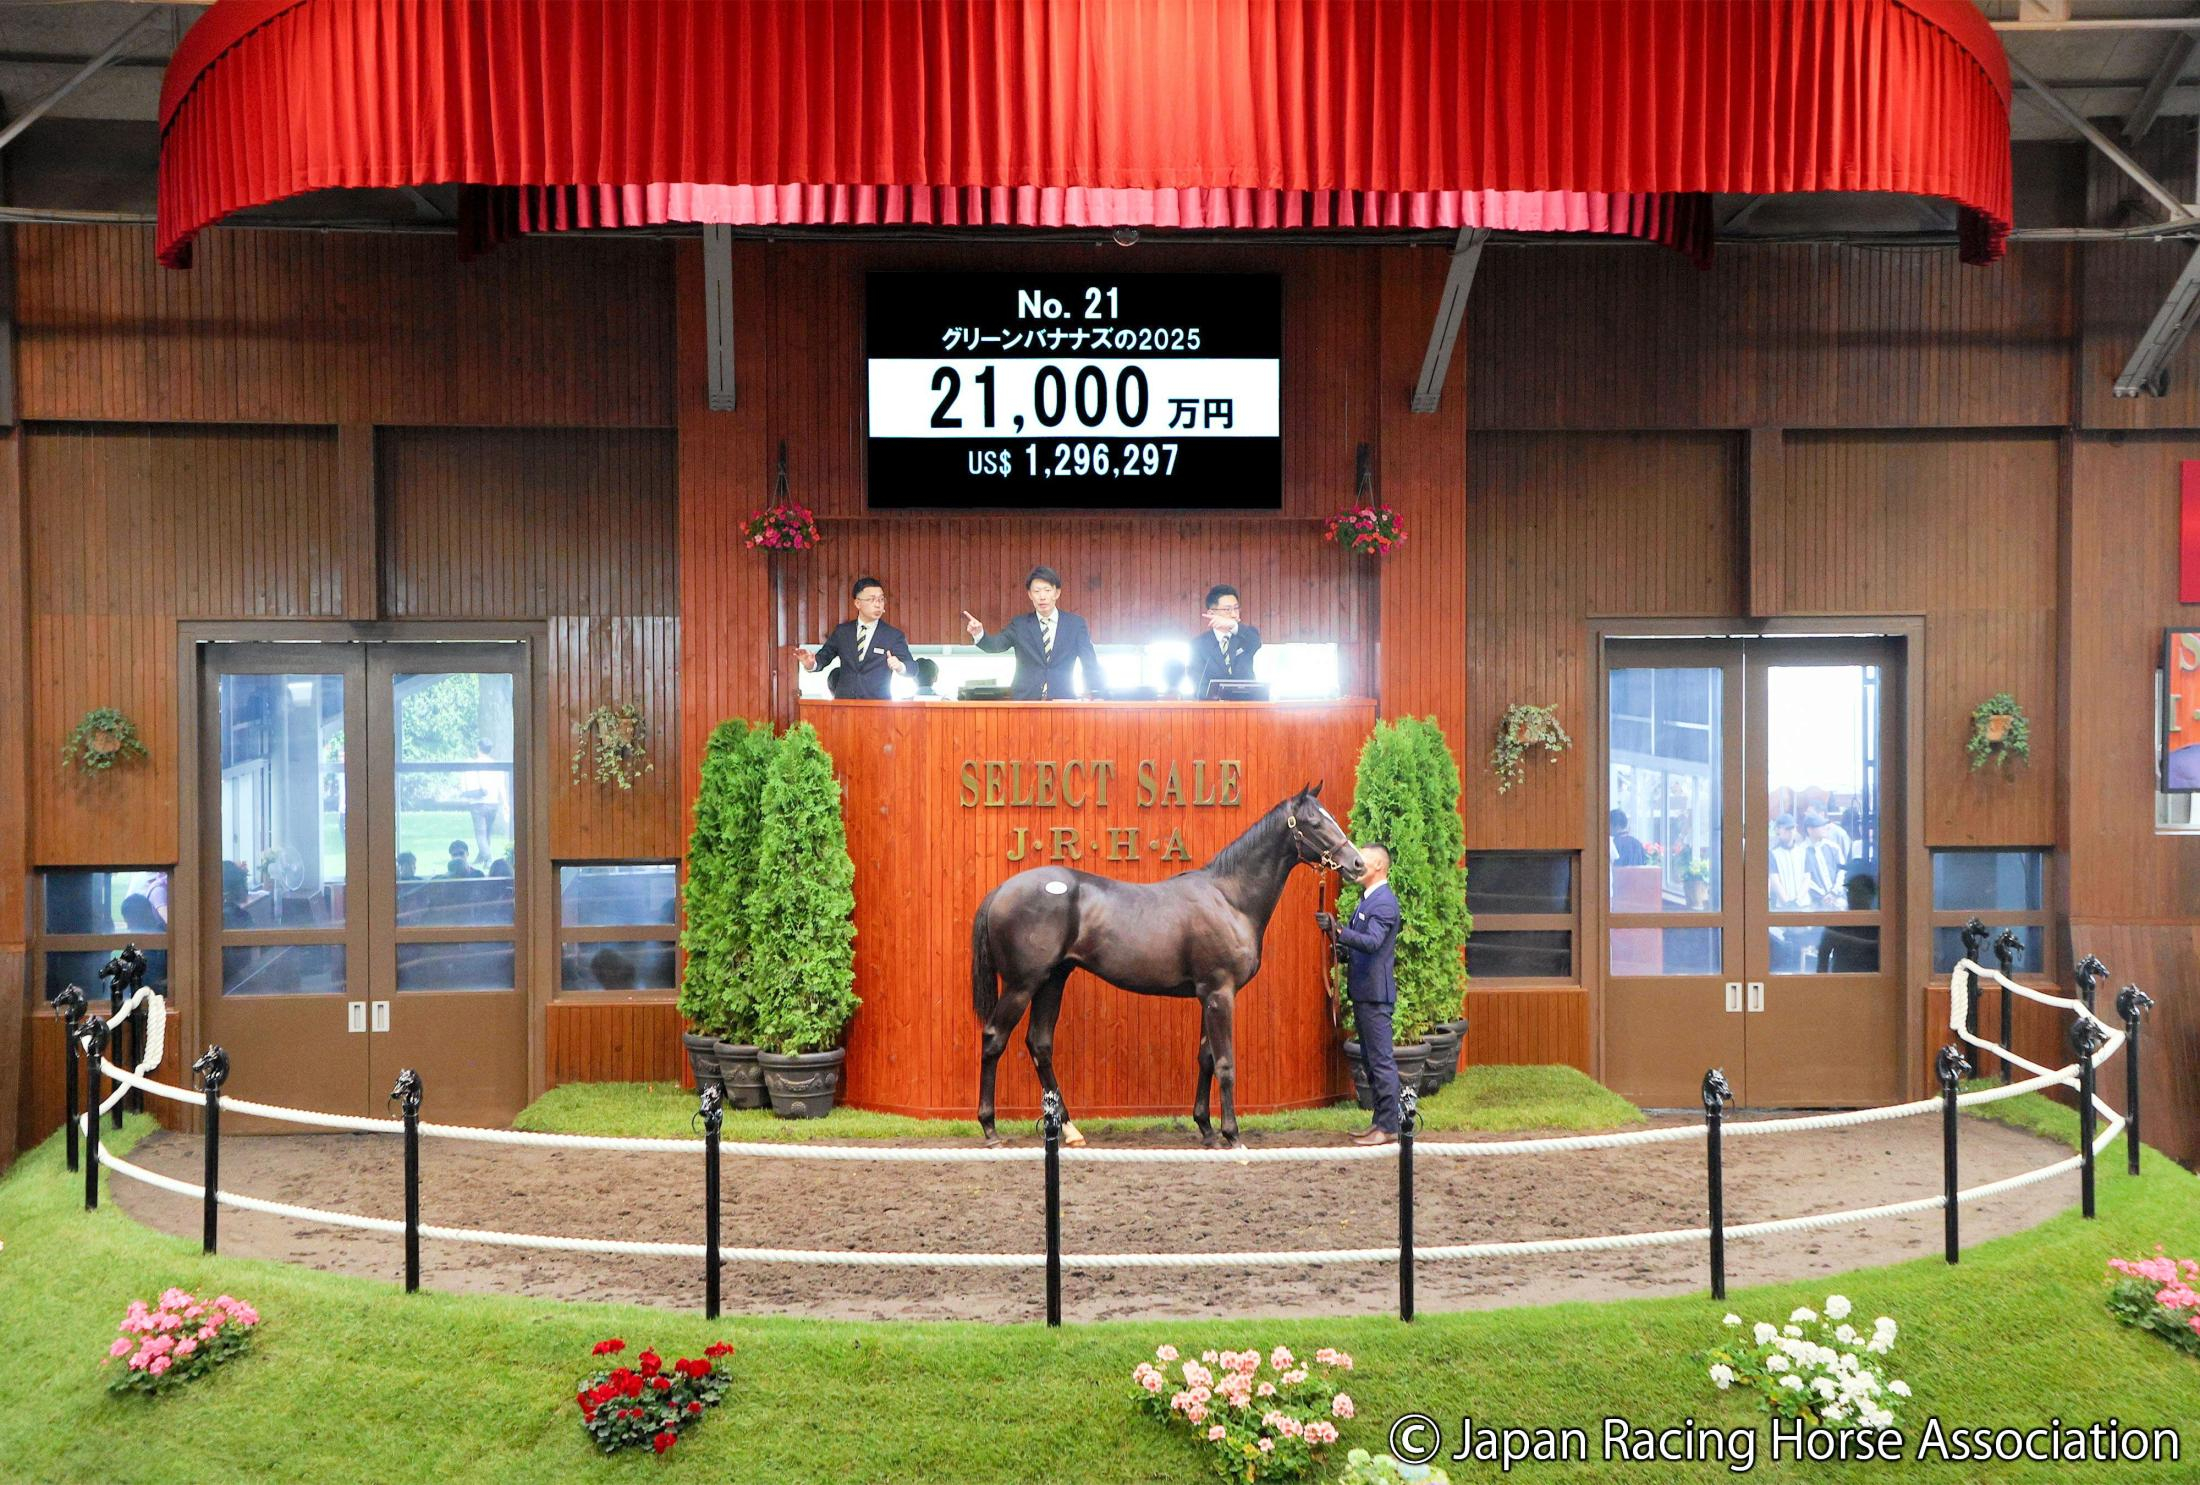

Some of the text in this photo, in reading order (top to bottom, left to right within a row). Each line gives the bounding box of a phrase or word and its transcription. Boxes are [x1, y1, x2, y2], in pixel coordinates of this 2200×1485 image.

[1018, 286, 1118, 319] No. 21
[941, 326, 1201, 351] グリーンバナナズの2025
[930, 364, 1234, 434] 21,000 万円
[968, 443, 1178, 479] US$ 1,296,297
[960, 759, 1241, 807] SELECT SALE
